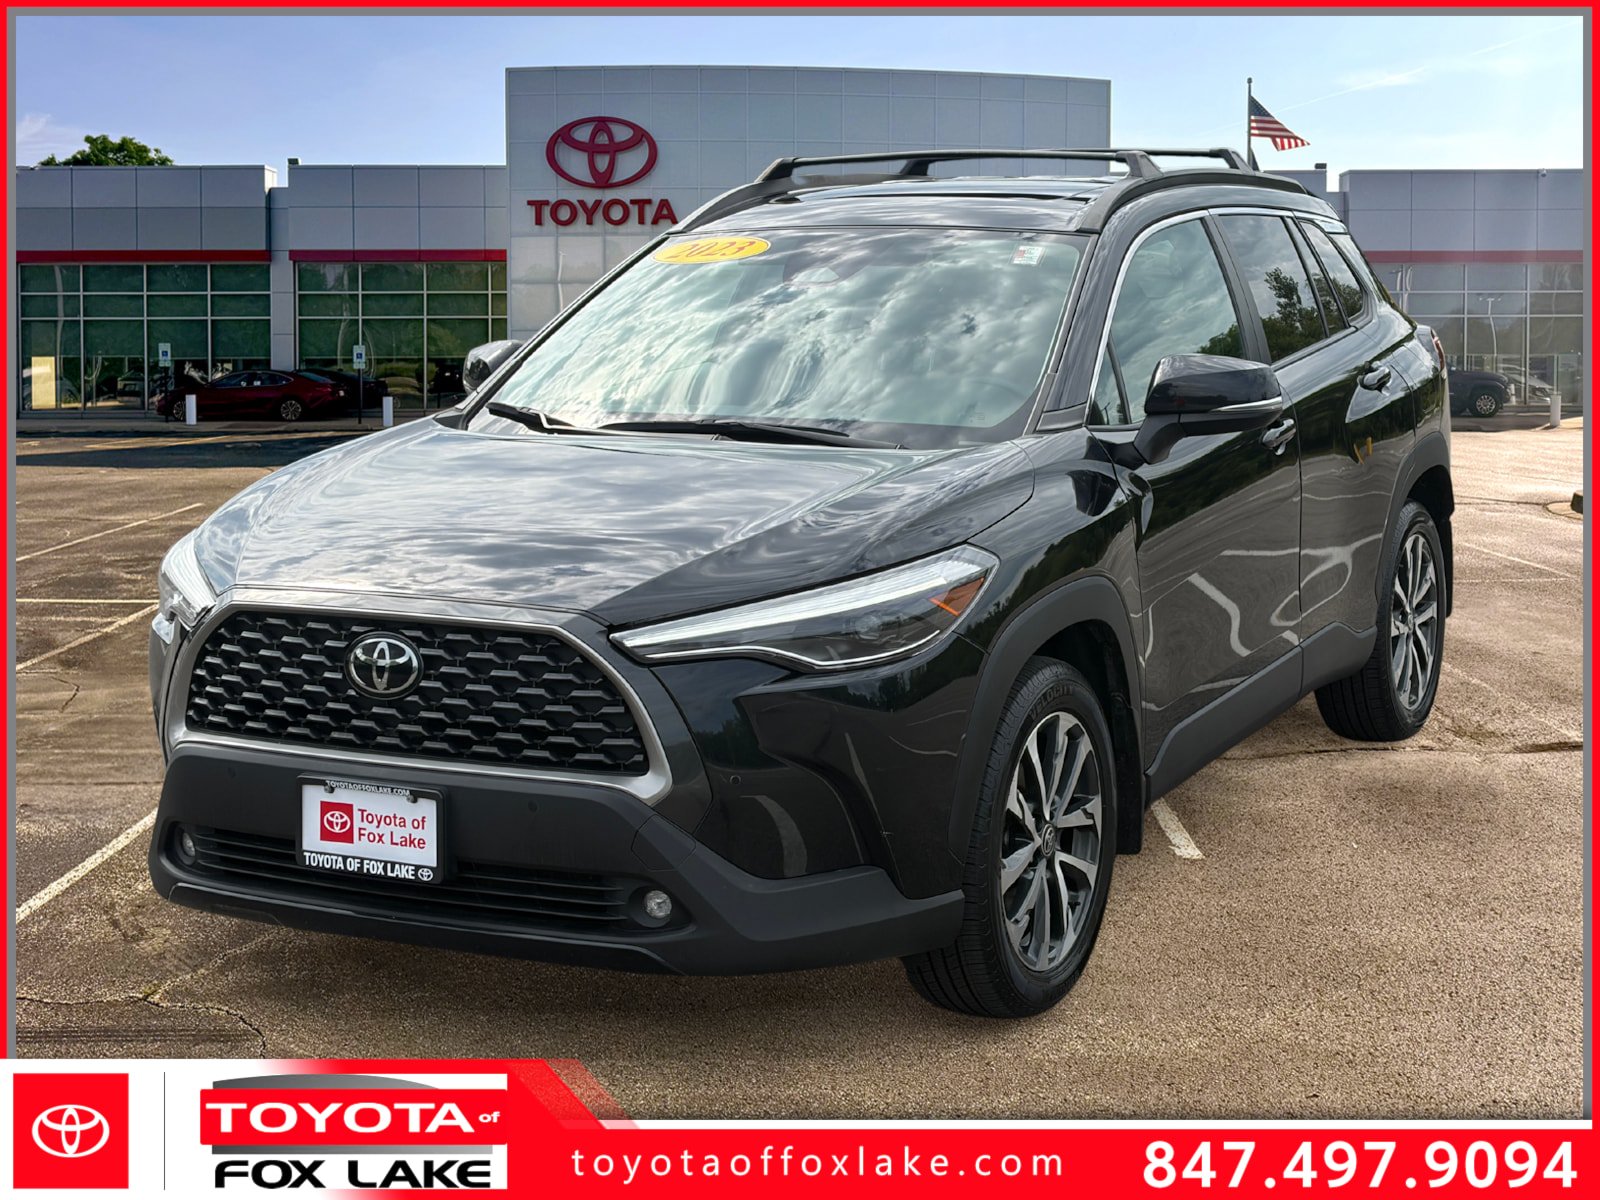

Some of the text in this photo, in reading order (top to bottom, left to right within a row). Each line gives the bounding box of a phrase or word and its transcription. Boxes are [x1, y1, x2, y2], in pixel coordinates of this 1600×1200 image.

[527, 199, 678, 226] TOYOTA
[664, 241, 756, 260] 2023
[325, 780, 411, 797] TOYOTAOFFOXLAKE.COM
[358, 808, 427, 830] Toyota of
[358, 827, 427, 849] Fox Lake
[303, 852, 416, 880] TOYOTA OF FOX LAKE
